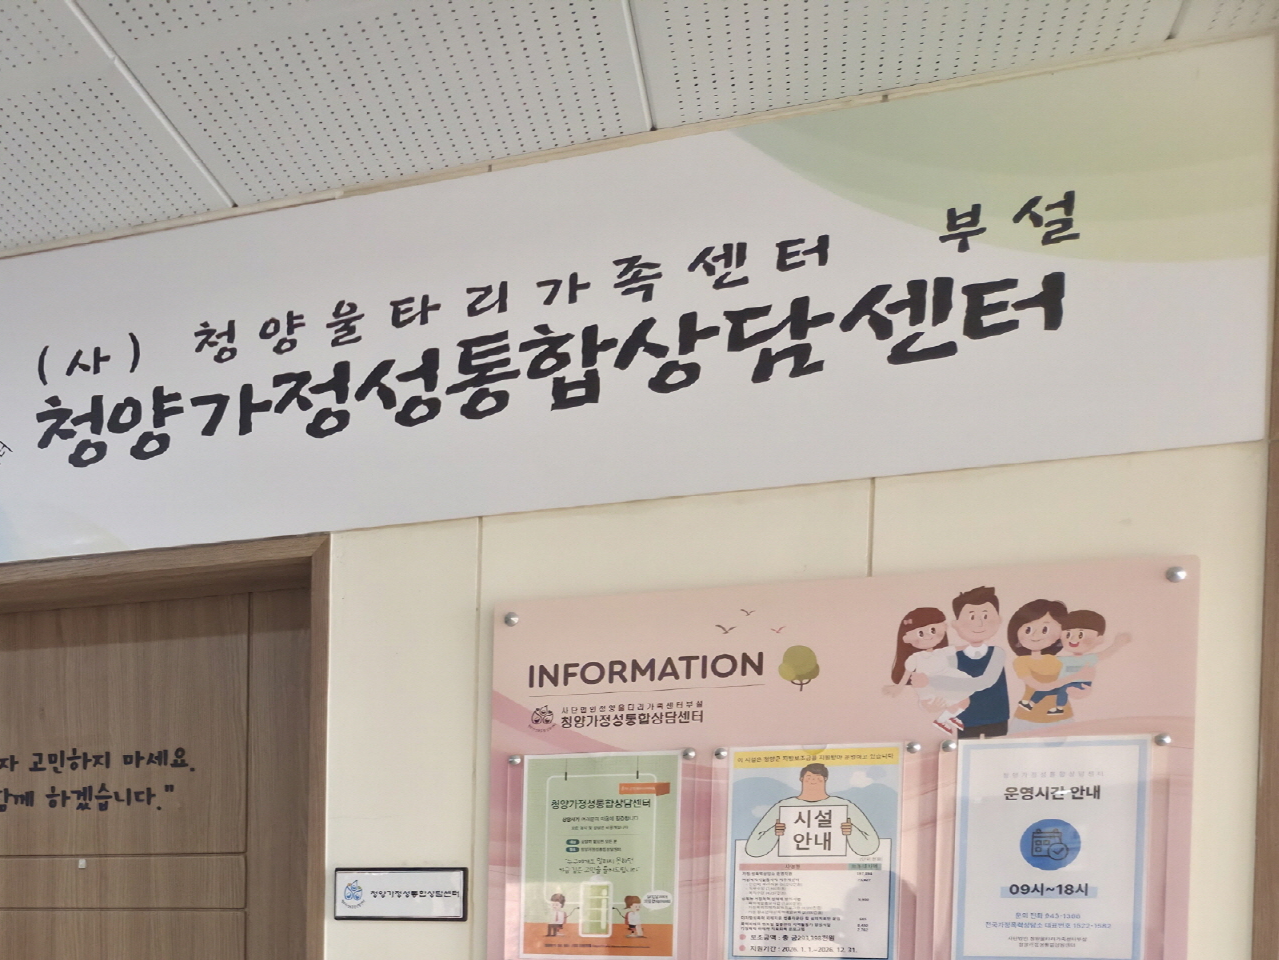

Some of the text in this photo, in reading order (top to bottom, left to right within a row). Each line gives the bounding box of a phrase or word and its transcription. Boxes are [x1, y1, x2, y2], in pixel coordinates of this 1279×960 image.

[37, 191, 1080, 387] (사) 청양울타리가족센터 부설
[35, 271, 1066, 469] 청양가정성통합상담센터
[529, 651, 764, 688] INFORMATION
[561, 710, 703, 728] 청양가정성통합상담센터
[29, 748, 111, 773] 고민하지
[123, 747, 195, 772] 마세요.
[1070, 785, 1100, 799] 안내
[551, 799, 651, 809] 청양가정성통합상담센터
[794, 809, 832, 828] 시설
[793, 832, 831, 851] 안내
[1009, 883, 1089, 896] 09시~18시
